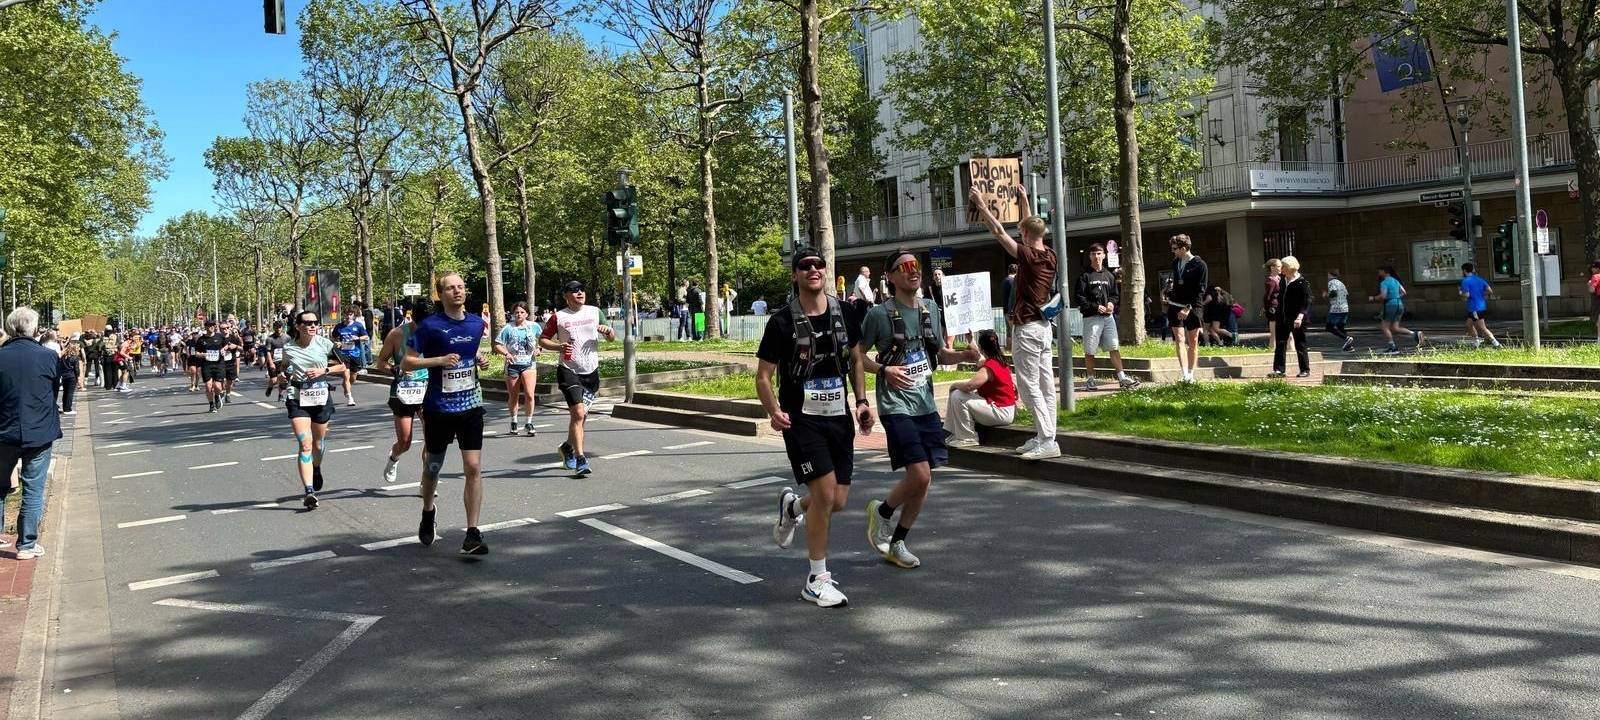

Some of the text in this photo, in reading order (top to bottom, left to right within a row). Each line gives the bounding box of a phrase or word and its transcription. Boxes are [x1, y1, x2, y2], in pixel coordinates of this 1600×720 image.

[972, 159, 990, 179] Did
[811, 391, 841, 402] 3855
[800, 461, 814, 475] EW
